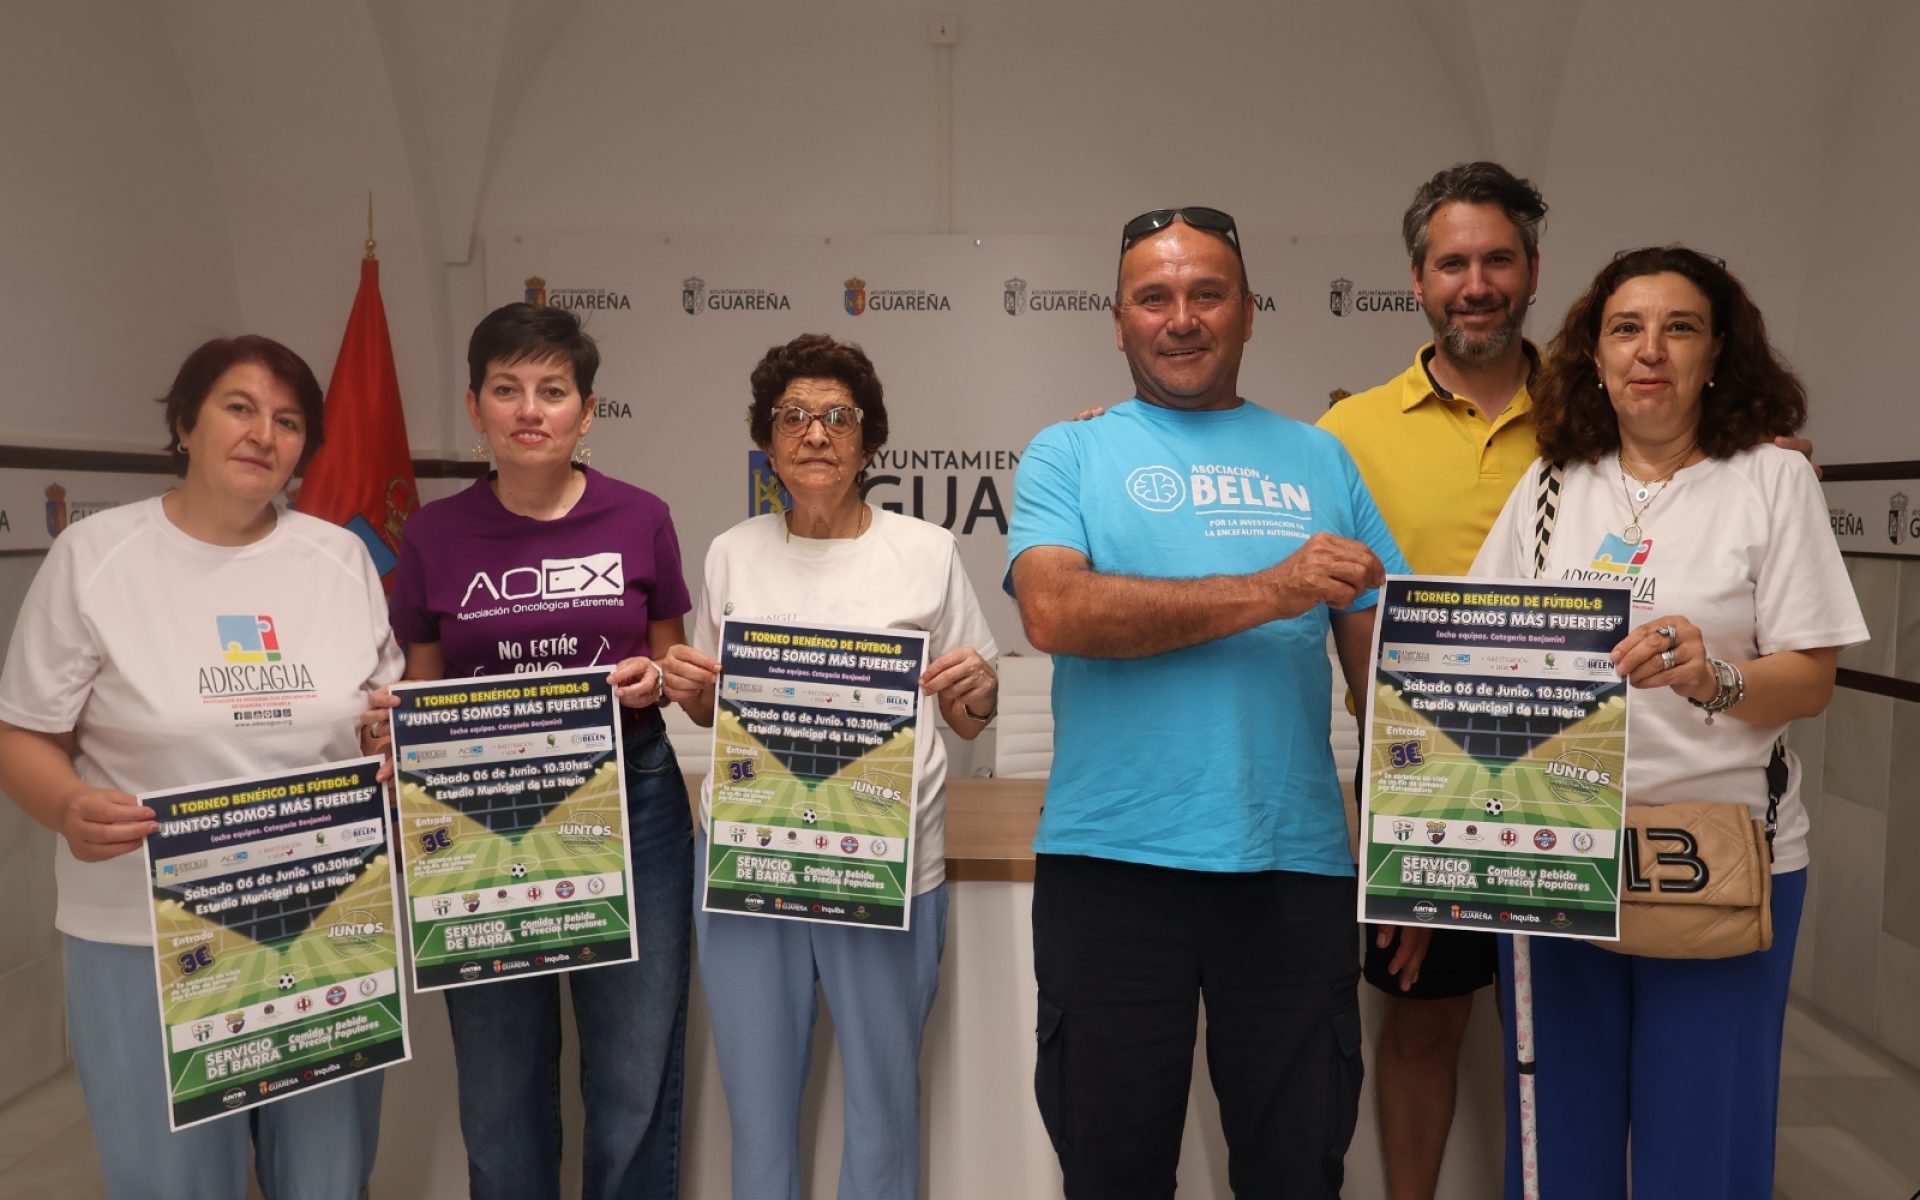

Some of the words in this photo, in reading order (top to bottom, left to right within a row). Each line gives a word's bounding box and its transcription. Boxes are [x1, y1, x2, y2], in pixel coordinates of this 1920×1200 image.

[549, 292, 631, 310] GUAREÑA
[708, 292, 791, 311] GUAREÑA
[869, 293, 951, 311] GUAREÑA
[1029, 293, 1112, 312] GUAREÑA
[1356, 296, 1419, 312] GUARE
[867, 450, 1019, 470] AYUNTAMIEN
[1191, 464, 1260, 479] ASOCIACIÓN
[1190, 475, 1311, 512] BELÉN
[461, 558, 622, 607] AOEX
[457, 606, 509, 621] Asociación
[513, 601, 569, 614] Oncológica
[573, 598, 624, 609] Extremeña
[1414, 590, 1459, 604] TORNEO
[1462, 590, 1520, 606] BENÉFICO
[1523, 595, 1538, 607] DE
[1543, 593, 1602, 609] FÚTBOL-8
[1450, 609, 1507, 625] SOMOS
[1509, 609, 1544, 627] MÁS
[498, 641, 522, 661] NO
[530, 633, 578, 658] ESTÁS
[752, 631, 789, 644] TORNEO
[792, 632, 838, 648] BENÉFICO
[840, 639, 852, 650] DE
[855, 638, 902, 654] FÚTBOL-8
[781, 648, 826, 664] SOMOS
[827, 651, 855, 667] MÁS
[199, 663, 315, 694] ADISCAGUA
[425, 692, 466, 706] TORNEO
[470, 685, 520, 702] BENÉFICO
[523, 686, 536, 697] DE
[539, 679, 589, 695] FÚTBOL-8
[1403, 678, 1452, 694] Sábado
[1455, 682, 1472, 695] 06
[1476, 683, 1493, 696] de
[1495, 683, 1533, 699] Junio.
[1537, 686, 1595, 701] 10.30hrs.
[461, 703, 510, 720] SOMOS
[513, 698, 542, 715] MÁS
[1411, 697, 1455, 711] Estadio
[1457, 700, 1513, 717] Municipal
[1516, 702, 1532, 716] de
[1534, 703, 1550, 717] La
[1554, 704, 1585, 718] Noria
[740, 706, 780, 721] Sábado
[782, 711, 796, 722] 06
[798, 712, 812, 724] de
[813, 713, 843, 728] Junio.
[846, 716, 891, 731] 10.30hrs.
[746, 722, 782, 736] Estadio
[782, 726, 827, 742] Municipal
[829, 730, 841, 742] de
[843, 731, 855, 743] La
[858, 732, 883, 745] Noria
[1385, 725, 1426, 737] Entrada
[725, 745, 758, 756] Entrada
[1390, 741, 1423, 768] 3€
[426, 770, 470, 787] Sábado
[473, 769, 488, 781] 06
[491, 767, 506, 779] de
[507, 763, 540, 778] Junio.
[543, 758, 592, 774] 10.30hrs.
[729, 759, 756, 782] 3€
[1545, 762, 1610, 785] JUNTOS
[182, 795, 228, 814] TORNEO
[231, 783, 286, 805] BENÉFICO
[289, 782, 303, 795] DE
[306, 770, 359, 792] FÚTBOL-8
[435, 786, 475, 801] Estadio
[476, 780, 525, 798] Municipal
[527, 778, 541, 791] de
[542, 777, 556, 789] La
[559, 773, 585, 787] Noria
[850, 780, 901, 800] JUNTOS
[222, 803, 276, 826] SOMOS
[278, 795, 310, 816] MÁS
[415, 814, 451, 827] Entrada
[557, 823, 612, 836] JUNTOS
[422, 828, 452, 853] 3€
[737, 855, 791, 872] SERVICIO
[1402, 856, 1471, 874] SERVICIO
[1487, 865, 1526, 877] Comida
[1540, 869, 1576, 880] Bebida
[184, 879, 233, 902] Sábado
[237, 876, 253, 891] 06
[256, 872, 272, 886] de
[274, 864, 309, 884] Junio.
[312, 853, 363, 875] 10.30hrs.
[736, 867, 752, 879] DE
[756, 868, 797, 884] BARRA
[1401, 869, 1421, 883] DE
[1426, 871, 1478, 888] BARRA
[1497, 877, 1534, 888] Precios
[1537, 879, 1590, 893] Populares
[195, 896, 239, 916] Estadio
[240, 884, 293, 907] Municipal
[296, 880, 310, 894] de
[311, 877, 325, 891] La
[328, 870, 355, 887] Noria
[327, 922, 384, 938] JUNTOS
[445, 920, 506, 939] SERVICIO
[520, 916, 553, 929] Comida
[565, 911, 595, 922] Bebida
[530, 924, 561, 936] Precios
[563, 918, 607, 933] Populares
[172, 929, 213, 947] Entrada
[445, 937, 463, 951] DE
[468, 930, 513, 948] BARRA
[179, 945, 214, 975] 3€
[288, 1025, 323, 1044] Comida
[336, 1014, 367, 1030] Bebida
[299, 1033, 332, 1050] Precios
[334, 1019, 379, 1041] Populares
[206, 1036, 273, 1067] SERVICIO
[206, 1062, 226, 1080] DE
[232, 1046, 281, 1073] BARRA
